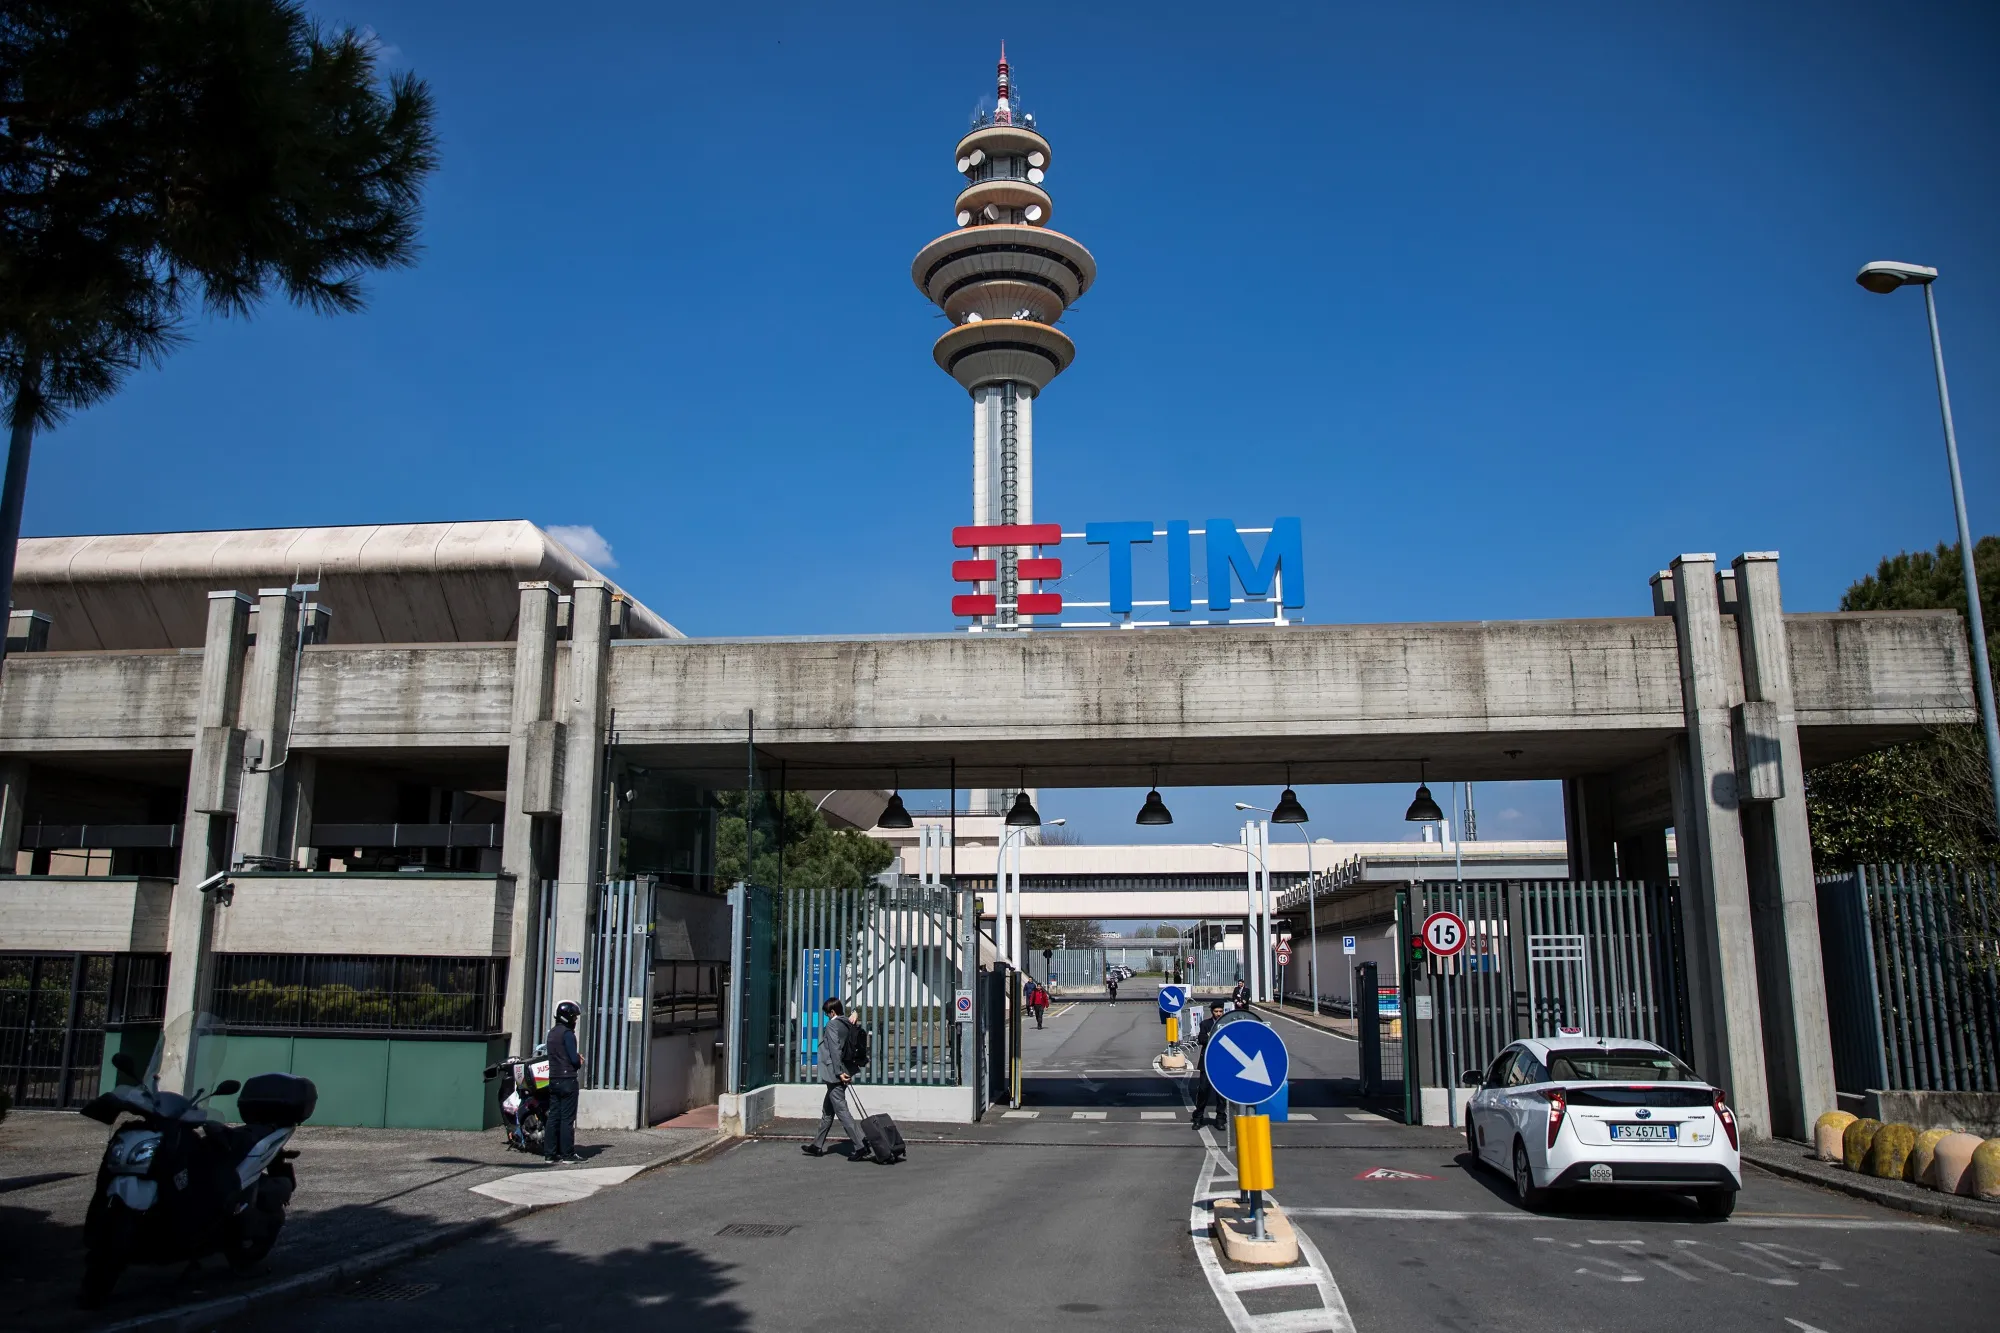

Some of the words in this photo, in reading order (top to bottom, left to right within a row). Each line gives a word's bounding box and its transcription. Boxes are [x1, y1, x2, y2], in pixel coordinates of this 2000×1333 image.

[1085, 517, 1305, 613] TIM
[1434, 925, 1456, 945] 15
[1346, 938, 1352, 946] P
[565, 957, 579, 965] TIM
[537, 1065, 549, 1074] JUS
[1592, 1169, 1611, 1177] 3585
